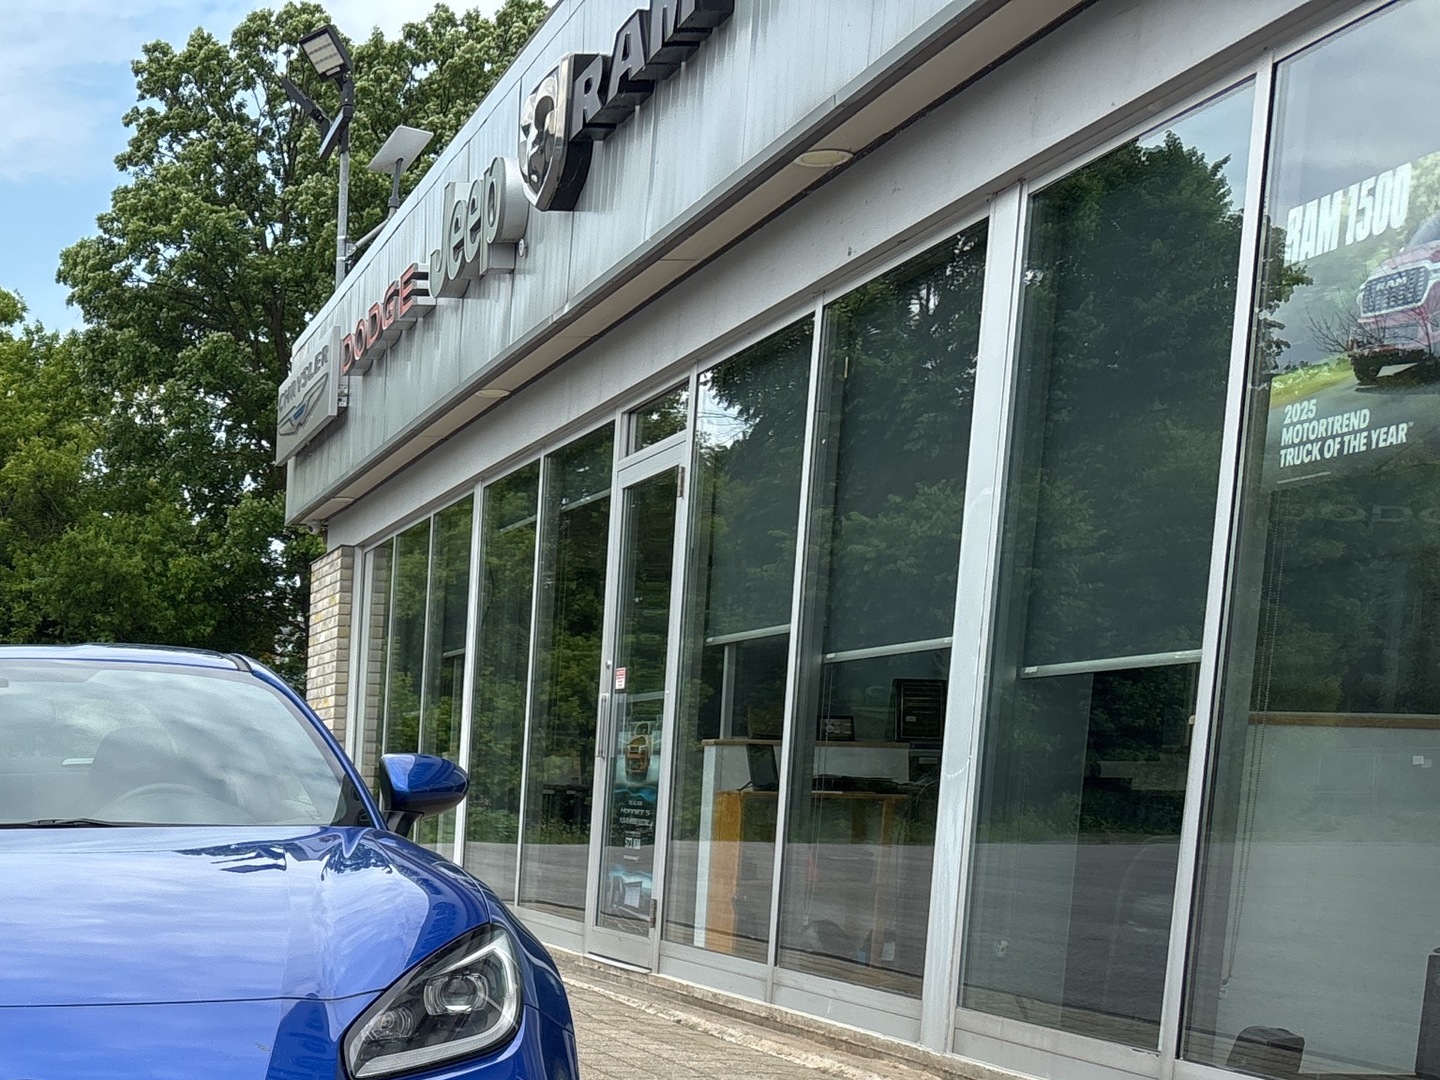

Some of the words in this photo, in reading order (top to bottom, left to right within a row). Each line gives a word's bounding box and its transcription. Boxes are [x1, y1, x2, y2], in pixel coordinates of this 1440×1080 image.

[429, 157, 506, 299] Jeep
[1283, 189, 1343, 268] RAM
[1345, 161, 1412, 246] 1500
[341, 262, 417, 376] DODGE
[279, 344, 329, 412] CHRYSLER
[1283, 399, 1317, 425] 2025
[1279, 440, 1321, 468] TRUCK
[1323, 436, 1342, 459] OF
[1343, 431, 1368, 456] THE
[1280, 408, 1370, 446] MOTORTREND
